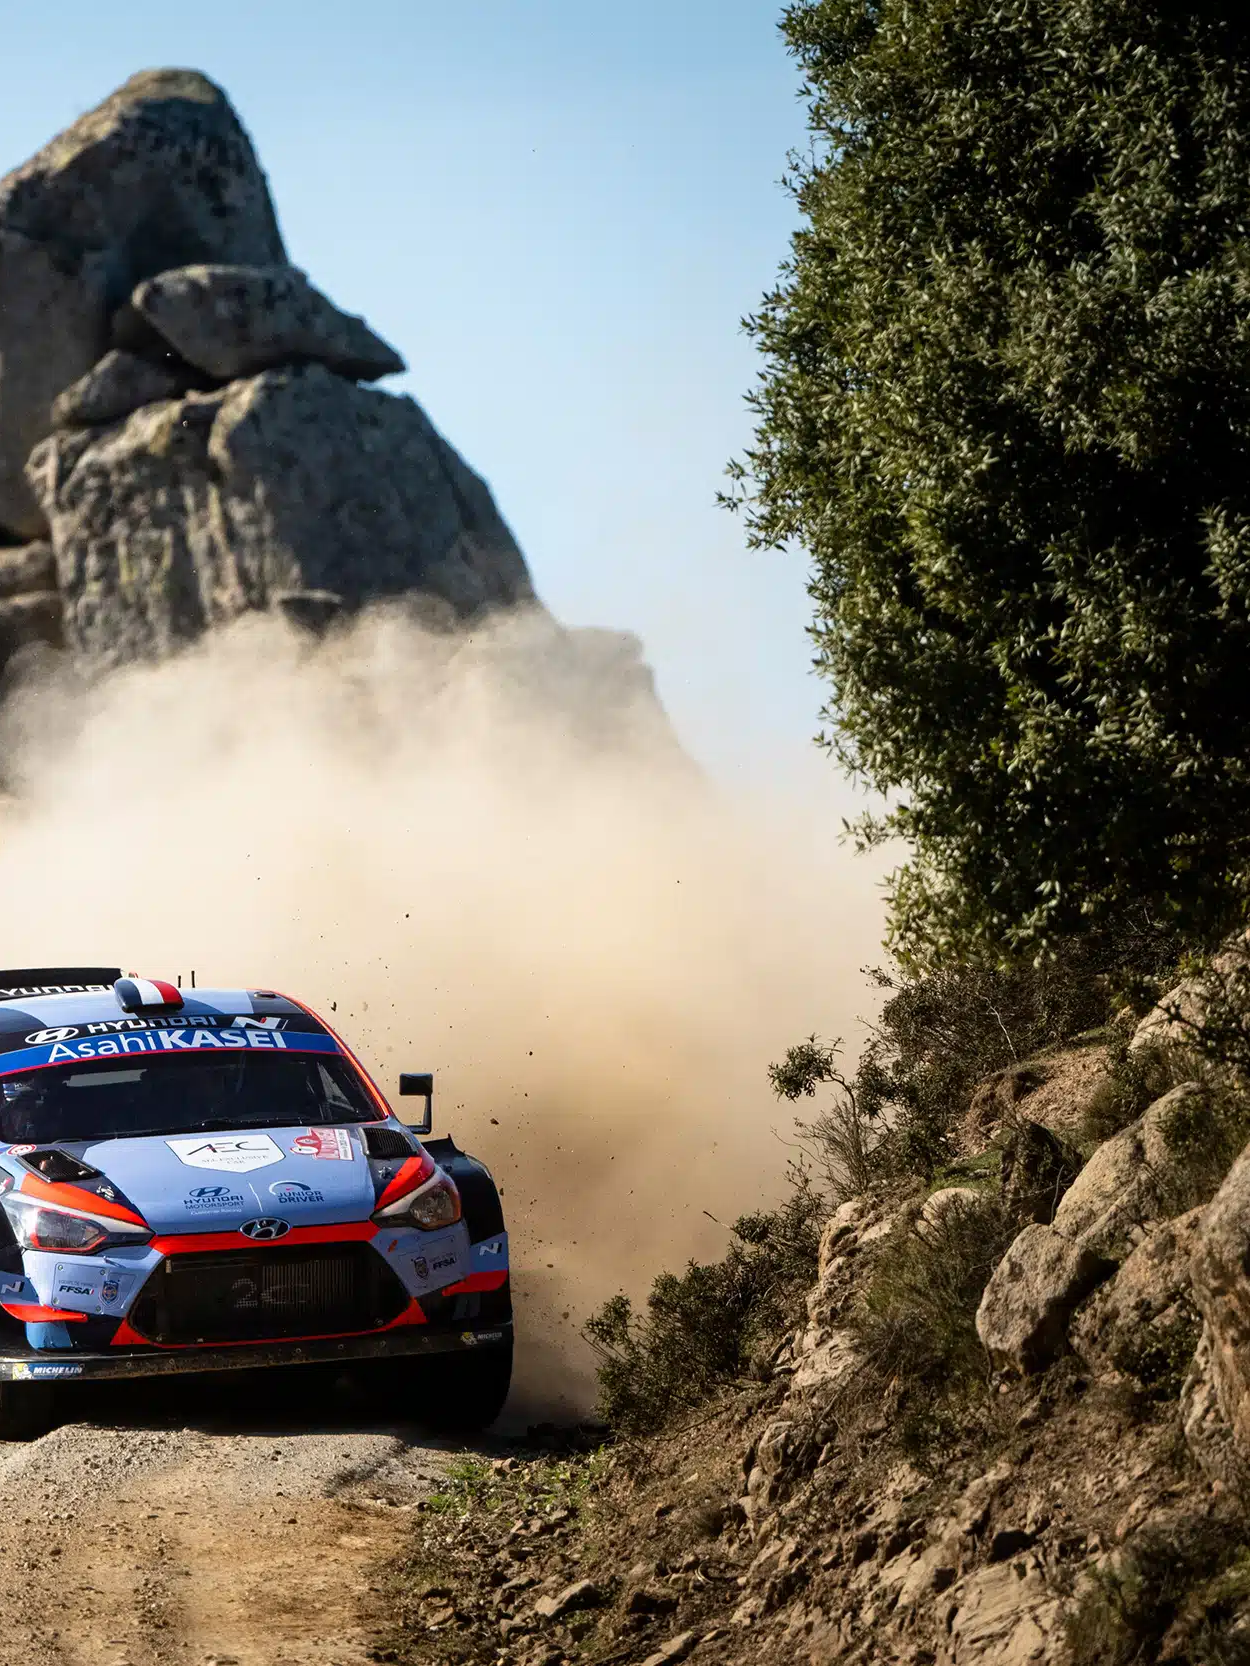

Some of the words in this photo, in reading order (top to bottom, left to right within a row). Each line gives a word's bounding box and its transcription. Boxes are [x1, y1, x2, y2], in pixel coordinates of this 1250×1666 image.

[86, 1016, 218, 1034] HYUNDAI
[48, 1029, 287, 1063] AsahiKASEI
[187, 1141, 269, 1155] AEC
[278, 1190, 322, 1198] JUNIOR
[183, 1195, 244, 1205] HYUNDAI
[279, 1196, 324, 1204] DRIVER
[185, 1201, 244, 1210] MOTORSPORT
[59, 1285, 90, 1295] FFSA
[33, 1366, 83, 1374] MICHELIN
